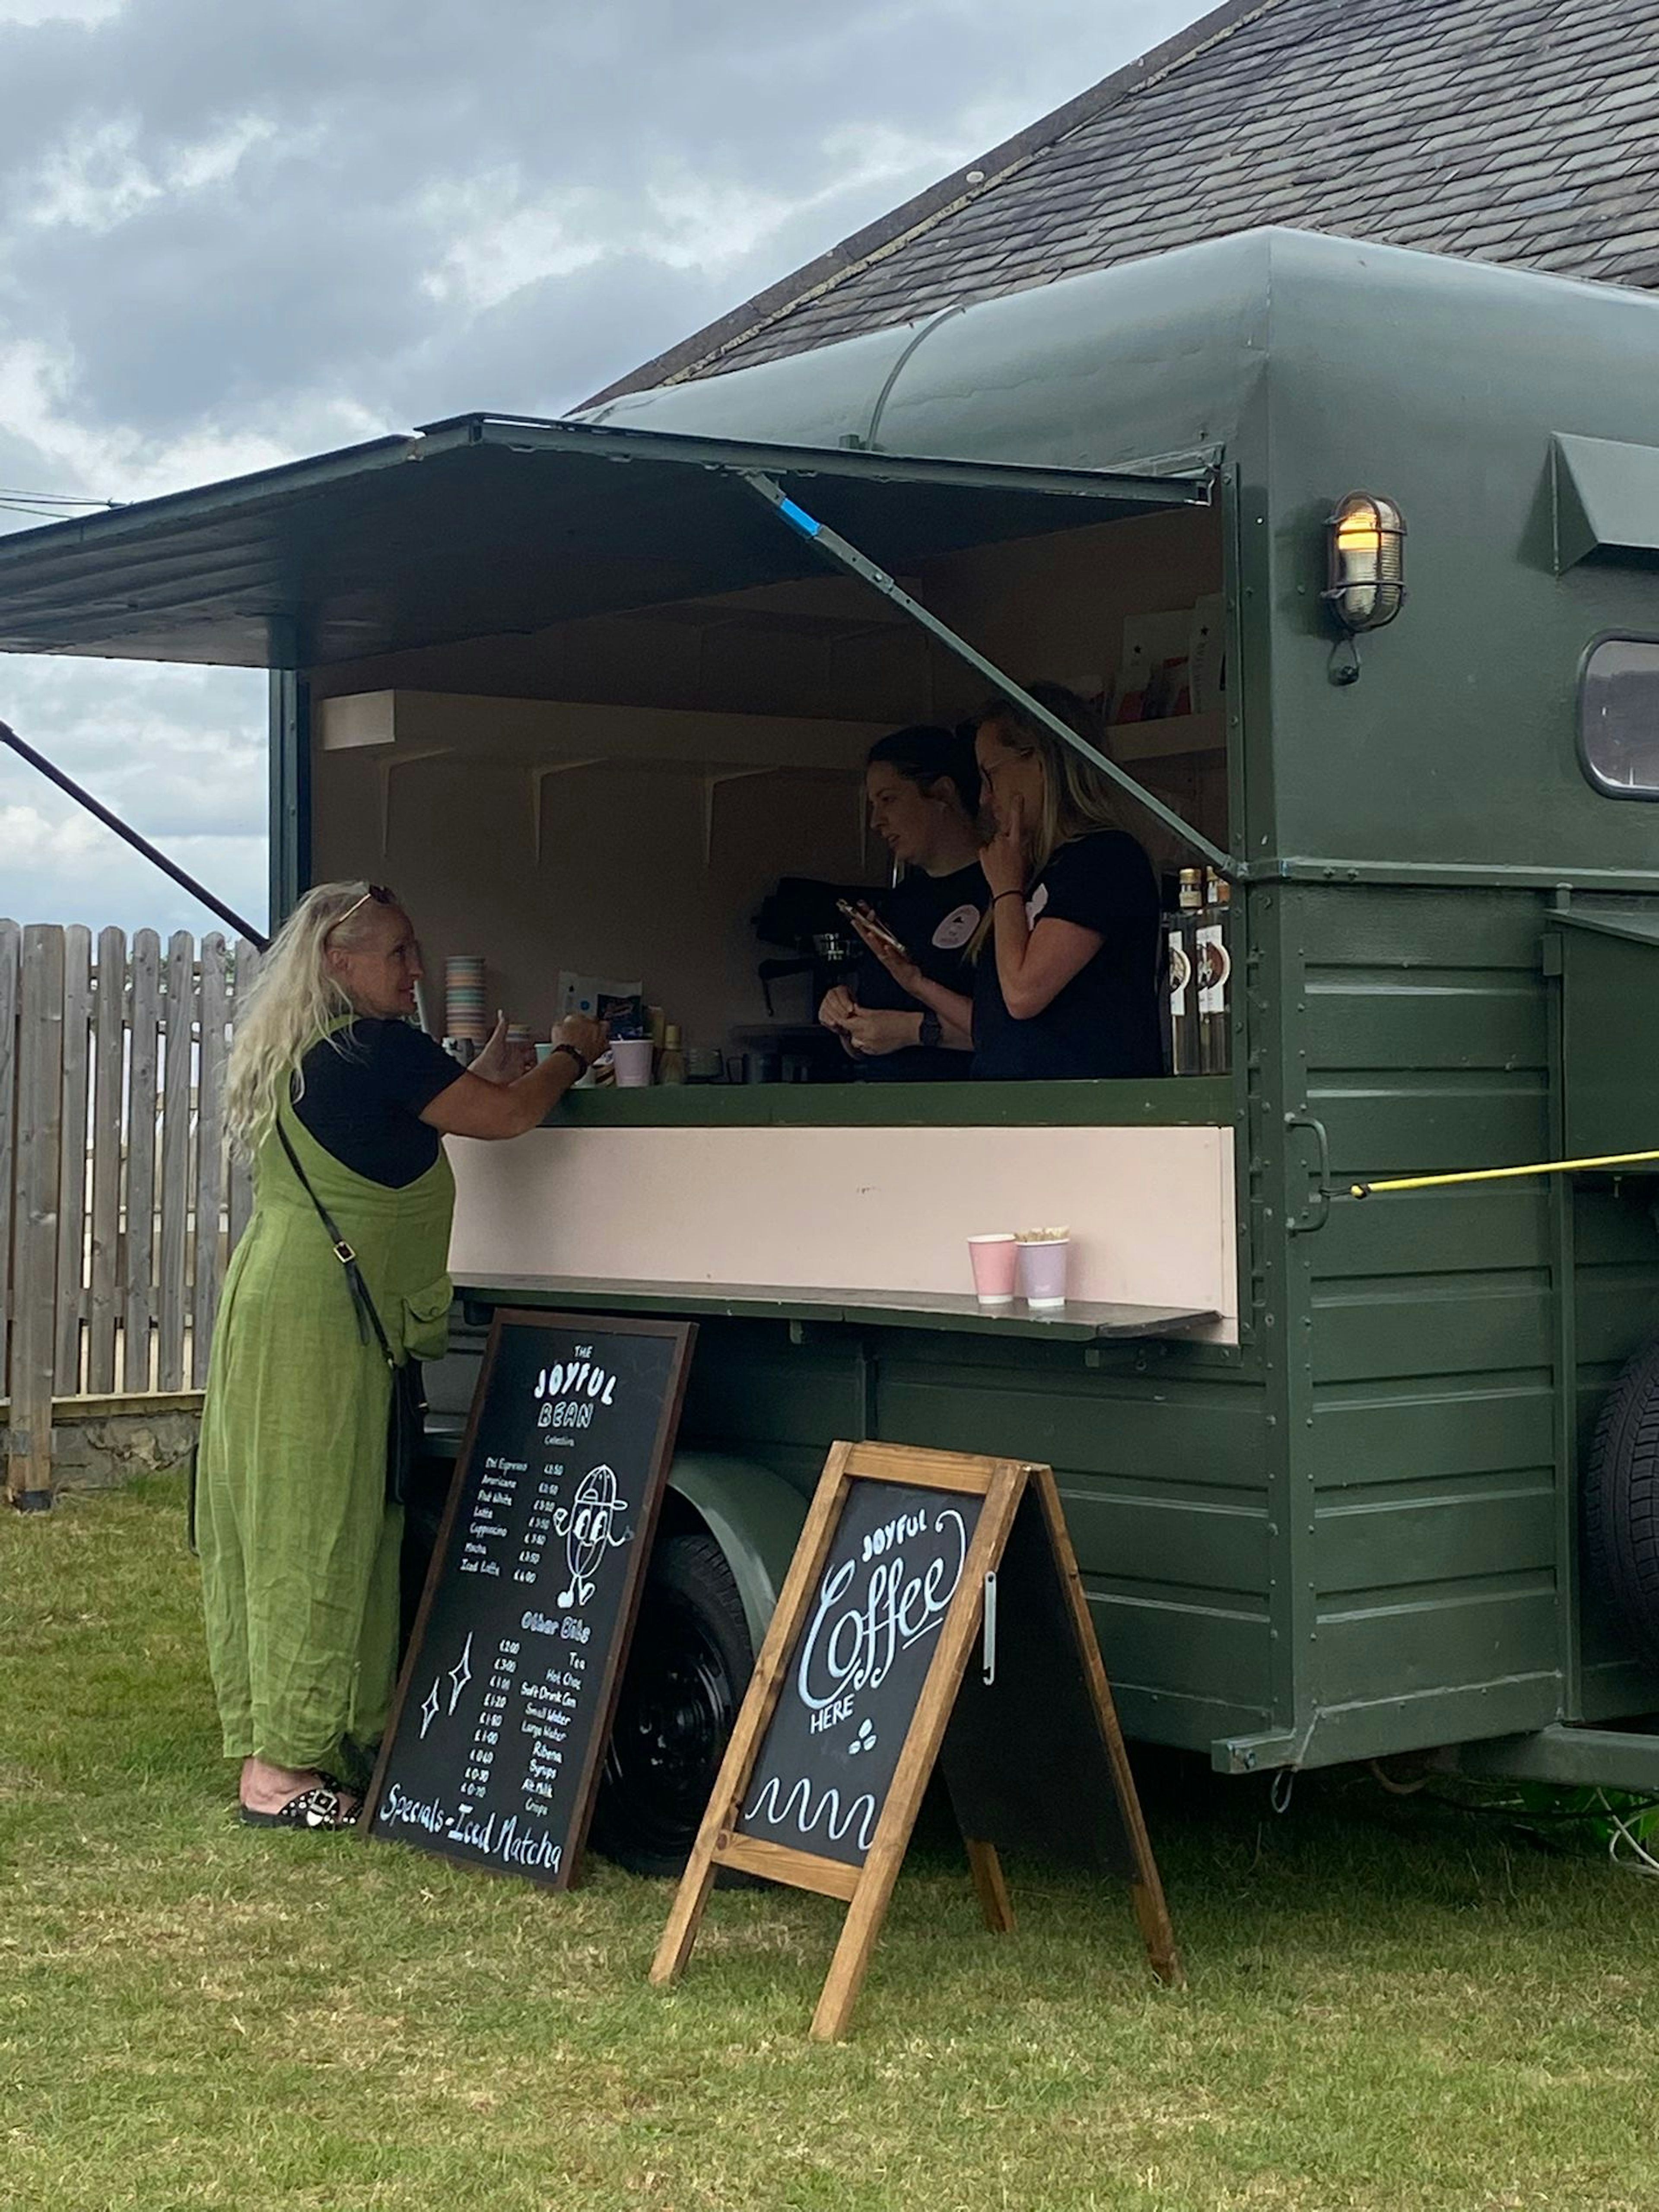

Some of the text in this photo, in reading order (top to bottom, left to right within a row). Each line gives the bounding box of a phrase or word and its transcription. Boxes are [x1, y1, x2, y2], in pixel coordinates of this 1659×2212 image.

[574, 1345, 593, 1358] THE
[534, 1362, 617, 1405] JOYFUL
[537, 1402, 594, 1428] BEAN
[498, 1457, 528, 1476] Espresso
[481, 1474, 517, 1489] Americano
[477, 1489, 492, 1503] Flat
[492, 1491, 512, 1506] White
[473, 1505, 493, 1519] Latte
[470, 1522, 508, 1538] Cappuccino
[861, 1508, 928, 1563] JOYFUL
[464, 1542, 487, 1554] Mocha
[460, 1558, 479, 1573] Iced
[480, 1560, 500, 1576] Latte
[798, 1510, 966, 1710] Coffee
[521, 1611, 591, 1644] Other Bits
[569, 1652, 586, 1670] Tea
[545, 1668, 562, 1685] Hot
[563, 1672, 582, 1691] Choc
[520, 1681, 539, 1698] Soft
[538, 1685, 563, 1703] Drink
[562, 1692, 577, 1708] Can
[525, 1702, 547, 1719] Small
[546, 1708, 572, 1726] Water
[810, 1692, 855, 1735] HERE
[521, 1720, 542, 1738] Large
[543, 1725, 567, 1742] Water
[533, 1740, 563, 1764] Ribena
[529, 1758, 557, 1780] Syrups
[535, 1782, 553, 1799] Milk
[524, 1796, 549, 1818] Crisps
[492, 1815, 563, 1875] Matcha
